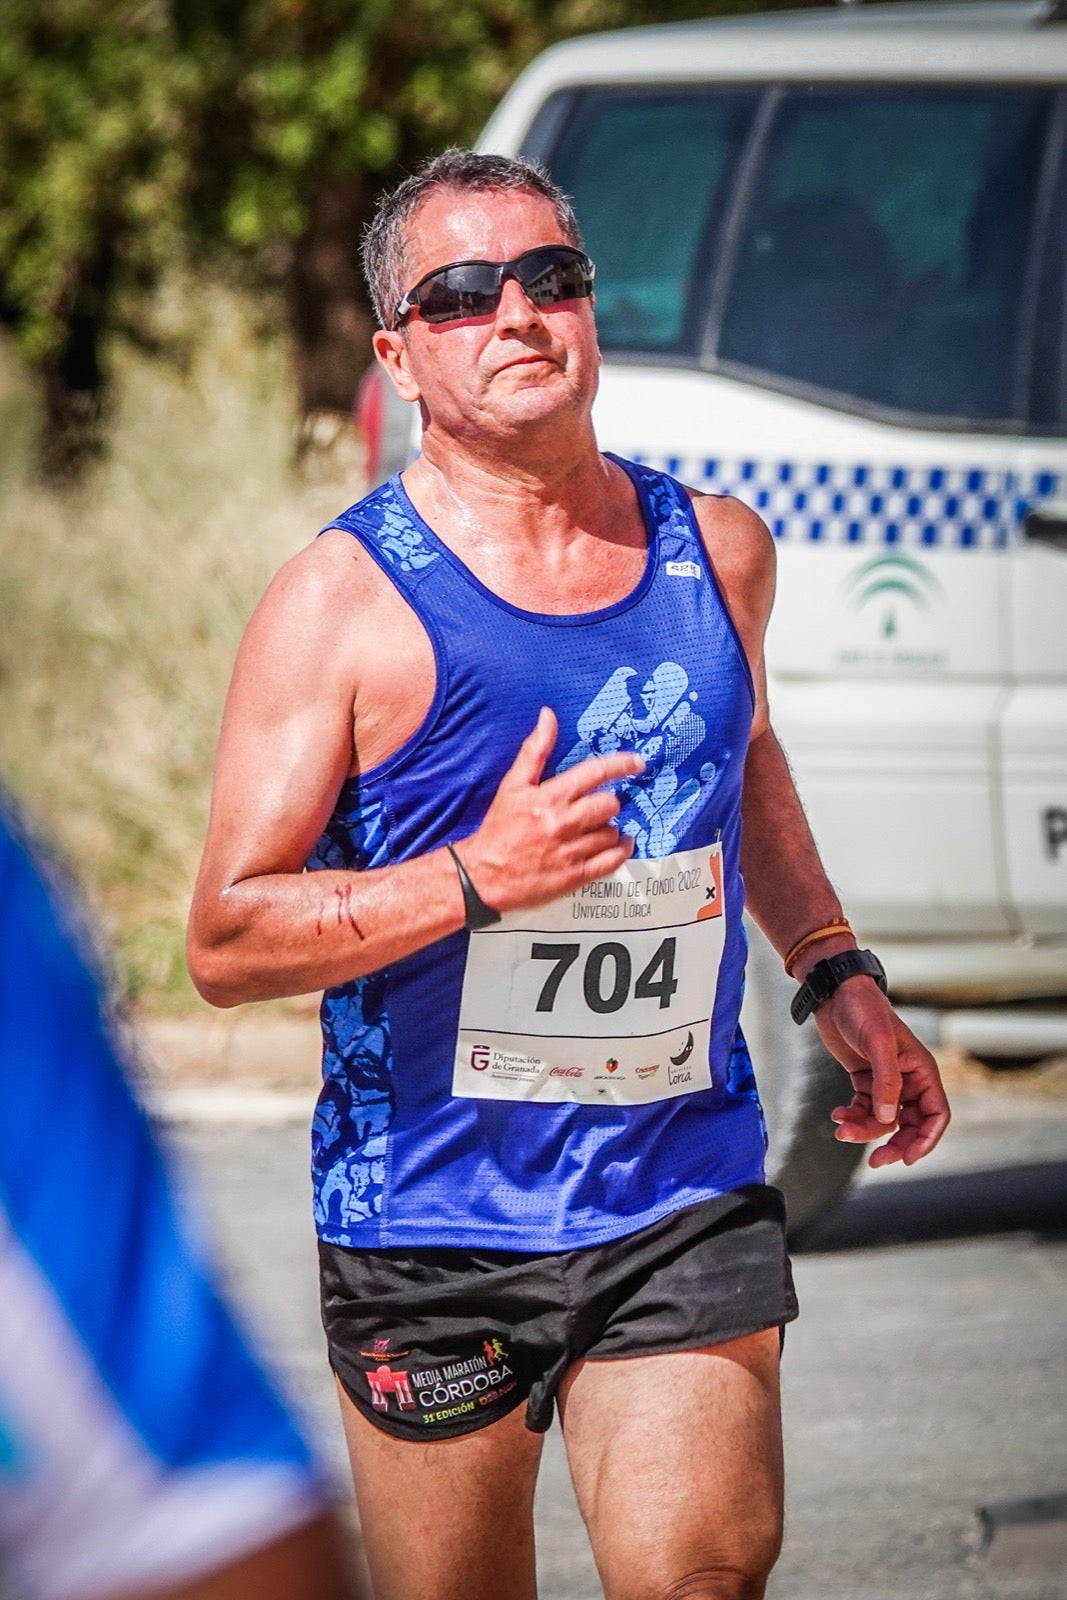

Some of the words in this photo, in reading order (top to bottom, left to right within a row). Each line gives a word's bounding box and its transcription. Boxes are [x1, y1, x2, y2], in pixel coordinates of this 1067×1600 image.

[581, 882, 623, 899] PREMIO
[627, 881, 641, 898] DE
[646, 876, 675, 896] FONDO
[678, 867, 702, 891] 2022
[572, 902, 620, 919] UNIVERSO
[624, 901, 651, 918] LORCA
[531, 937, 678, 1014] 704
[492, 1061, 502, 1071] de
[503, 1063, 541, 1074] Granada
[493, 1052, 541, 1065] Diputación
[411, 1369, 443, 1388] MEDIA
[443, 1355, 488, 1380] MARATÓN
[418, 1365, 513, 1407] CÓRDOBA
[422, 1413, 436, 1424] 31
[436, 1402, 475, 1421] EDICIÓN
